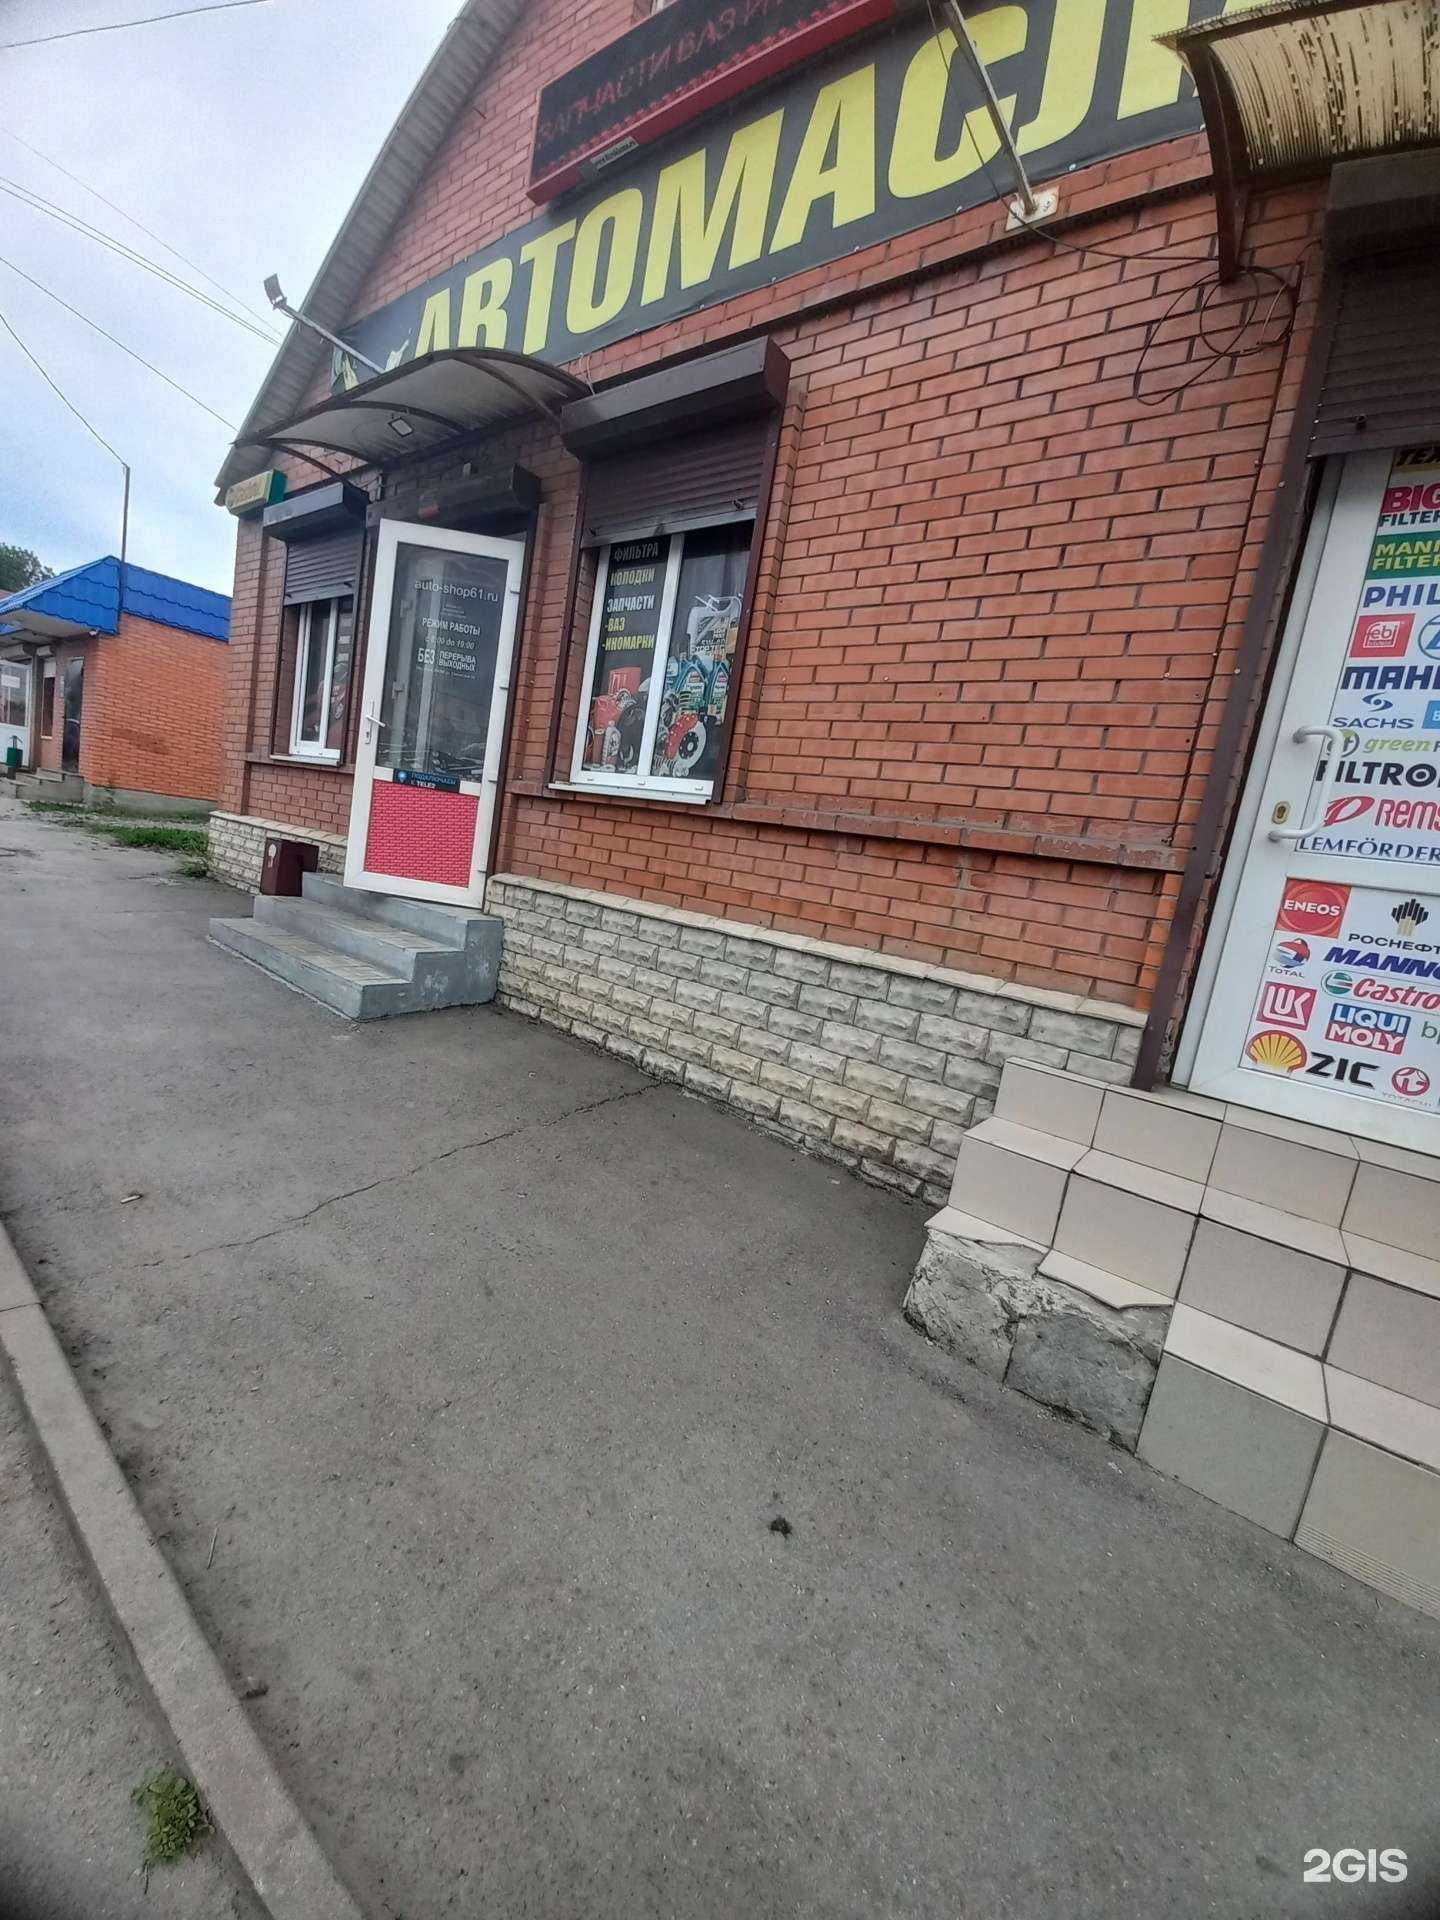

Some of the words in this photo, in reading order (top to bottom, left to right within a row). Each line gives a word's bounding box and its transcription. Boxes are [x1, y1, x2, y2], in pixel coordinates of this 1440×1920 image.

[415, 0, 1250, 358] АВТОМАСЛ
[610, 568, 655, 586] КОЛОДКИ
[415, 580, 499, 602] auto-shop61.ru
[607, 595, 655, 613] ЗАПЧАСТИ
[449, 621, 481, 637] РАБОТЫ
[417, 647, 436, 665] БЕЗ
[439, 650, 477, 665] ПЕРЕРЫВА
[438, 659, 476, 672] ВЫХОДНЫХ
[1332, 717, 1414, 729] SACHS
[1299, 836, 1440, 862] LEMFÖRDER
[1283, 899, 1340, 917] ENEOS
[1268, 965, 1306, 979] TOTAL
[1353, 978, 1440, 1010] Castro
[1333, 1004, 1407, 1034] LIQUI
[1328, 1023, 1405, 1052] MOLY
[1305, 1051, 1380, 1088] ZIC
